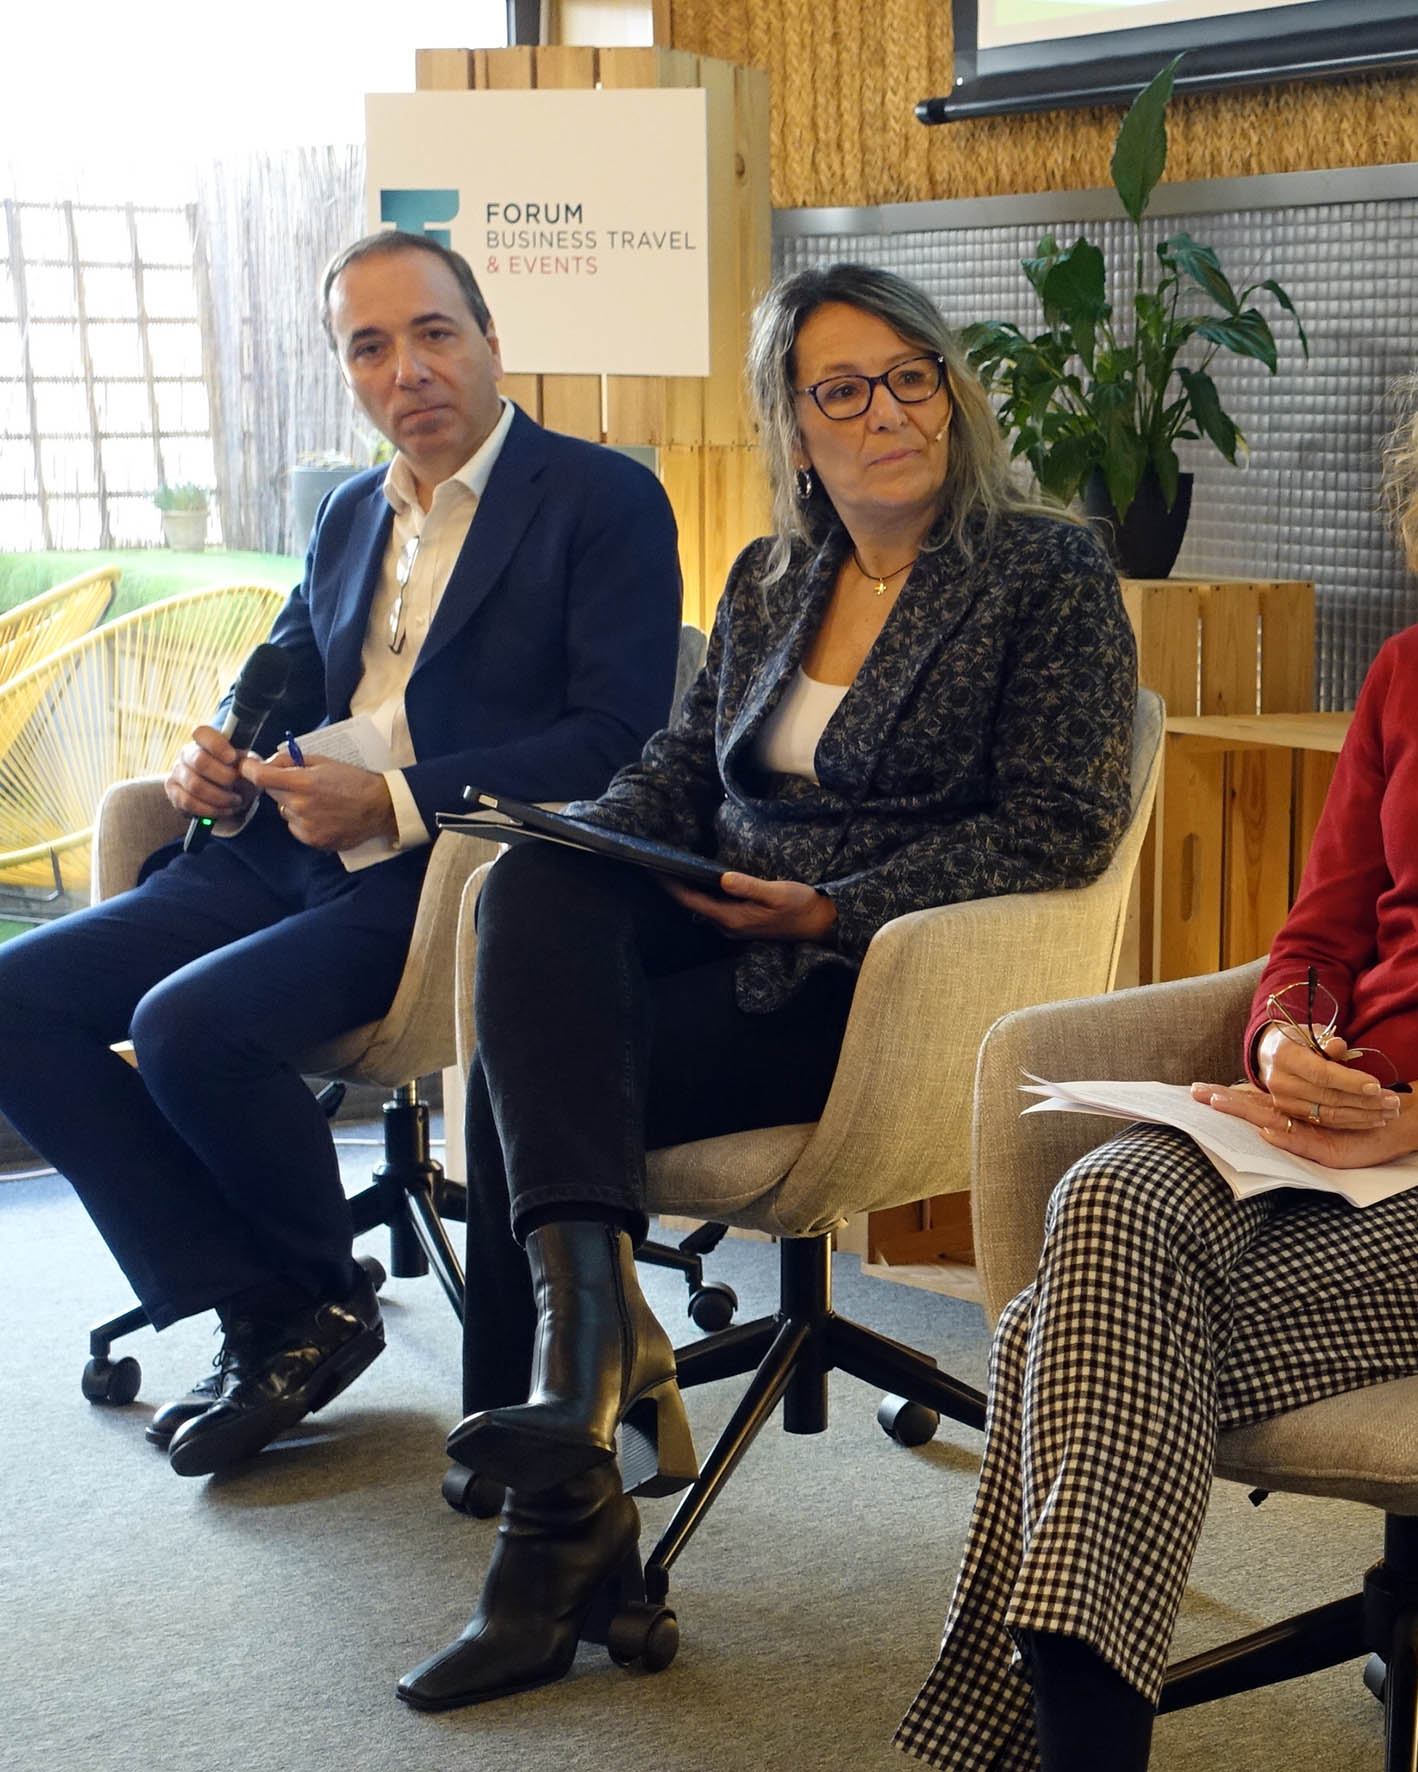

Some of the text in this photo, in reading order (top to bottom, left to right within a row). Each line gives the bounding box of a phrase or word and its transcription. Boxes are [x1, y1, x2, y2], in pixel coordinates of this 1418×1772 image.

[486, 202, 583, 225] FORUM
[486, 230, 697, 250] BUSINESS TRAVEL
[486, 255, 598, 275] & EVENTS
